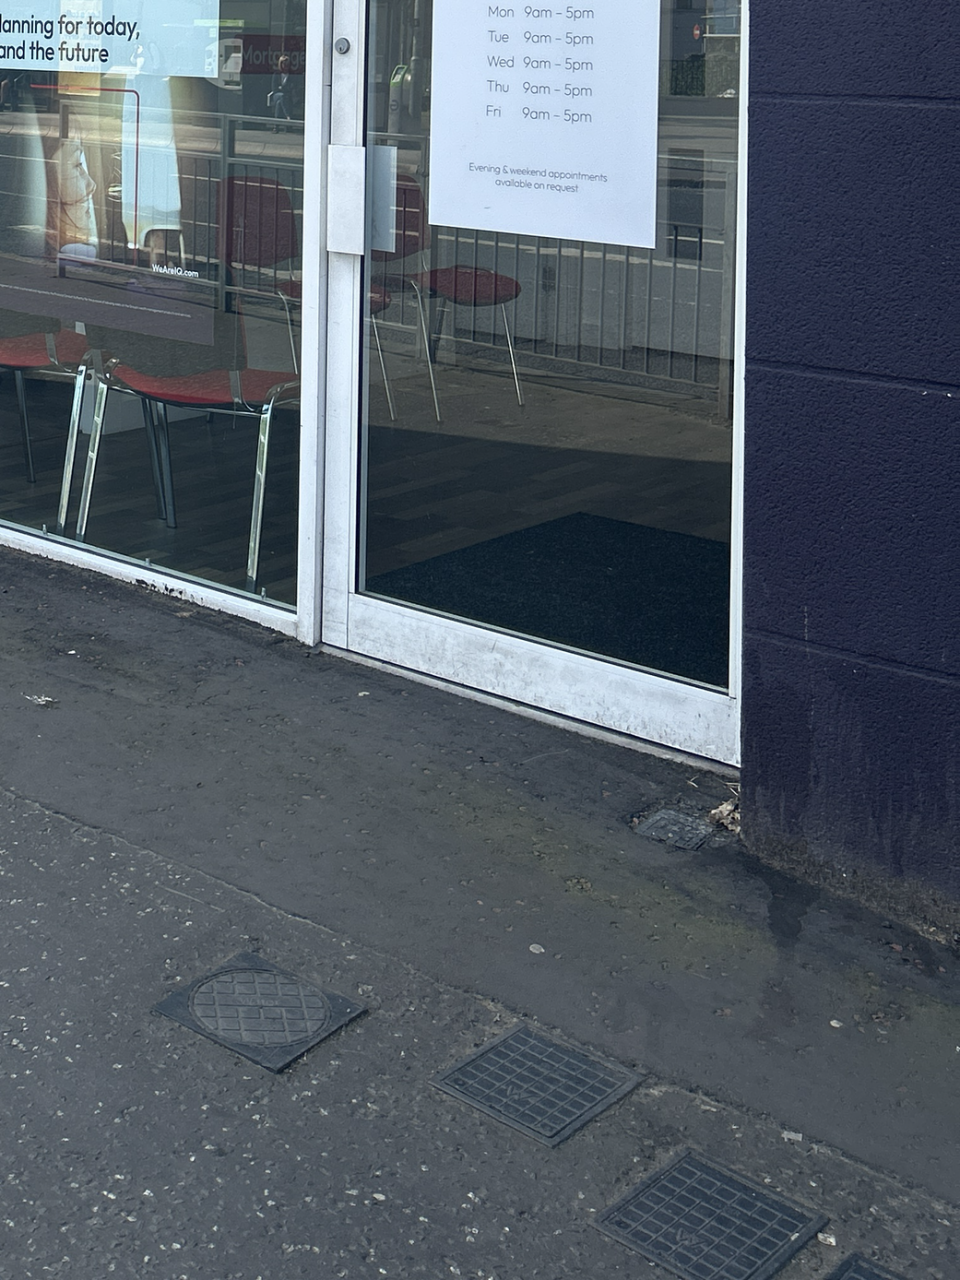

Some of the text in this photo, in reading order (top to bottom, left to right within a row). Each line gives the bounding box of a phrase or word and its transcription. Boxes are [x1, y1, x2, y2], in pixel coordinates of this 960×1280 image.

[488, 6, 514, 18] Mon
[524, 5, 552, 18] 9am
[565, 6, 594, 21] 5pm
[57, 15, 83, 34] for
[86, 15, 140, 41] today,
[488, 30, 509, 43] Tue
[523, 30, 552, 43] 9am
[565, 31, 594, 47] 5pm
[29, 40, 55, 61] the
[58, 41, 109, 63] future
[487, 55, 515, 68] Wed
[523, 56, 551, 69] 9am
[564, 57, 593, 73] 5pm
[486, 79, 509, 93] Thu
[522, 81, 551, 94] 9am
[564, 83, 593, 99] 5pm
[486, 104, 502, 118] Fri
[522, 106, 550, 120] 9am
[563, 109, 592, 125] 5pm
[468, 162, 608, 183] Evening & weekend appointments
[495, 178, 579, 193] available on request
[151, 263, 199, 278] WeAreIQ.com
